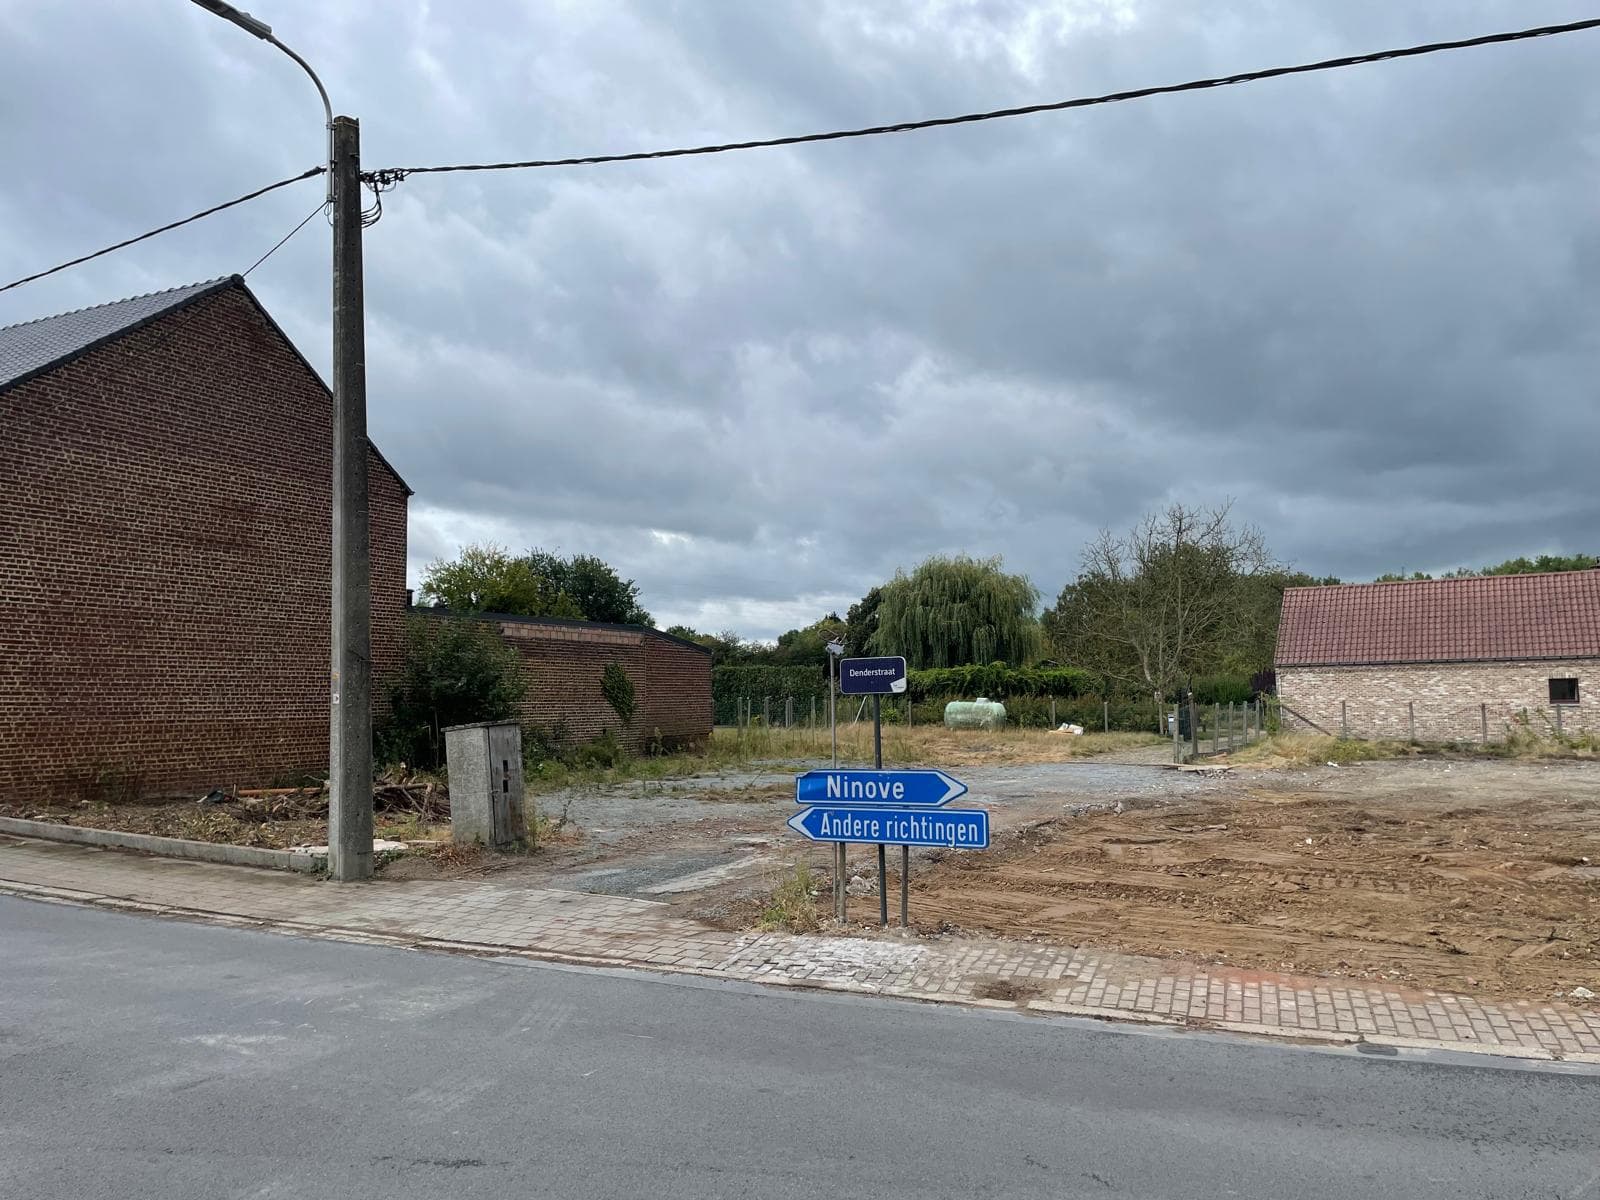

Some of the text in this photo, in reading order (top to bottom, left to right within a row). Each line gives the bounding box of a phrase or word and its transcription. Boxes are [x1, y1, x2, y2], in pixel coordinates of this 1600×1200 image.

[849, 667, 896, 677] Denderstraat
[826, 775, 905, 799] Ninove
[820, 812, 978, 847] Andere richtingen
